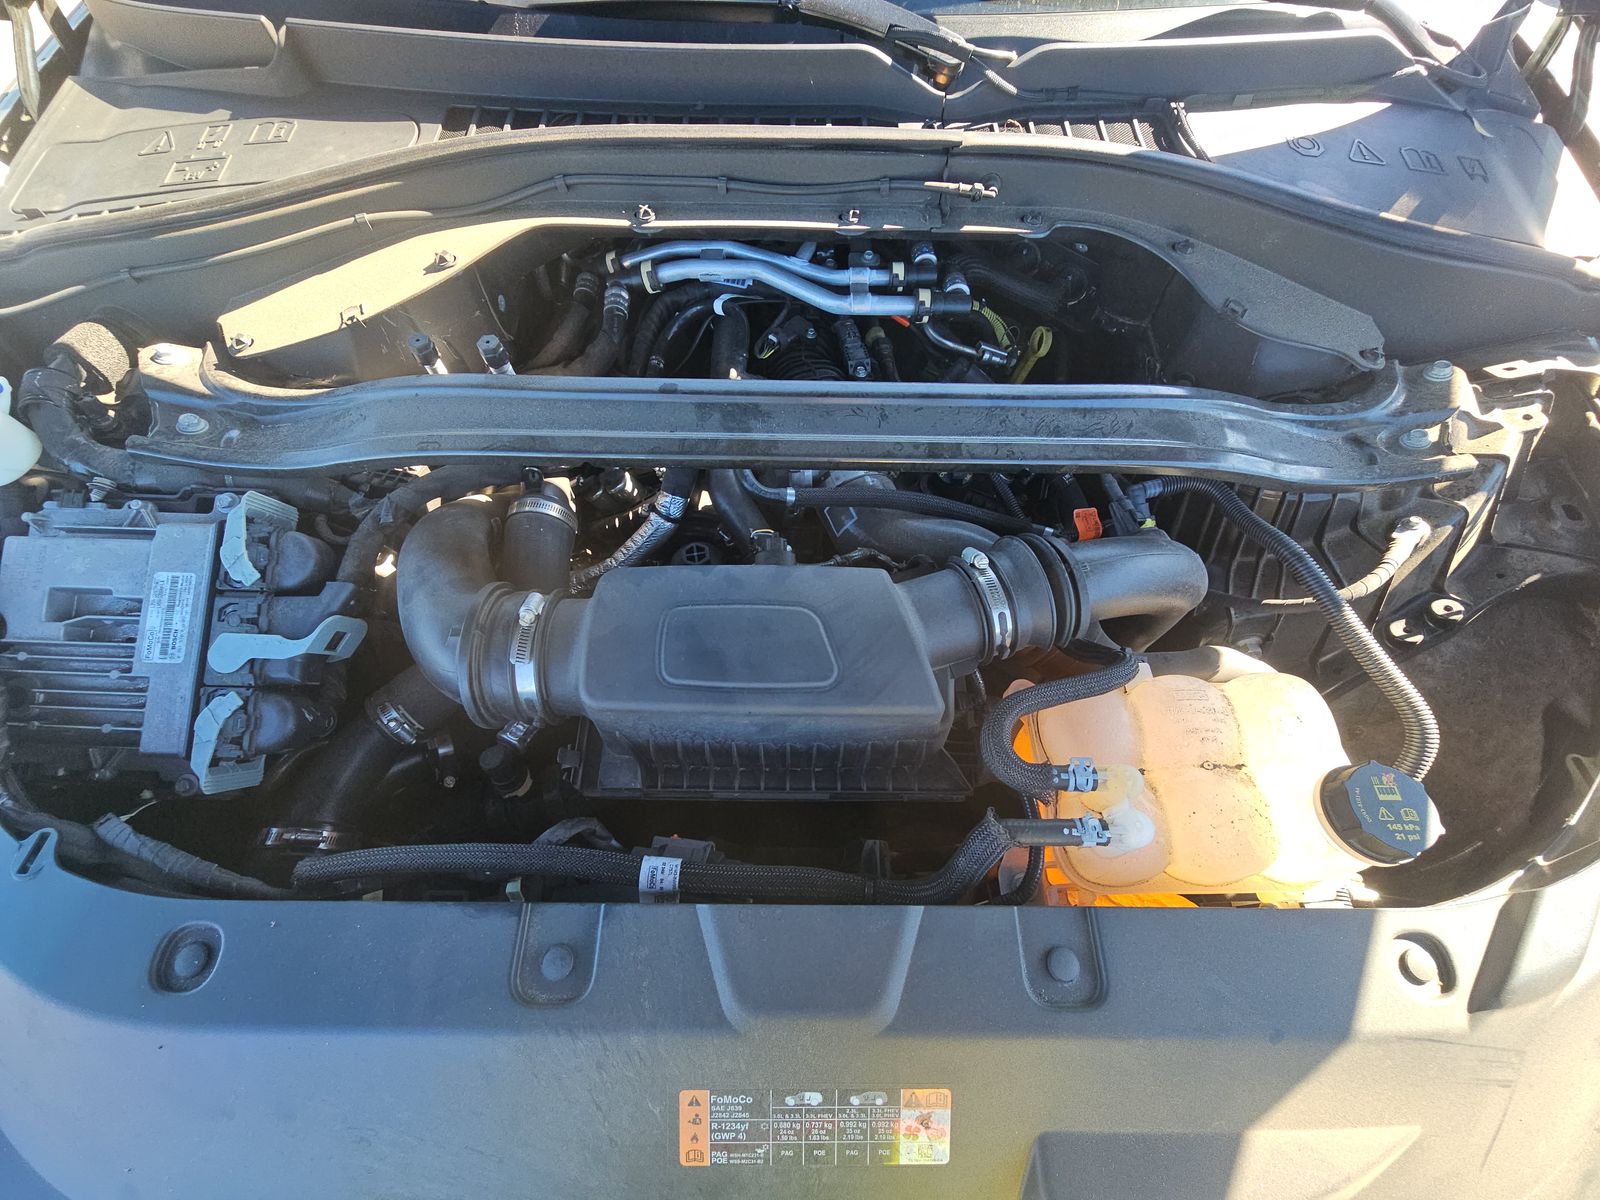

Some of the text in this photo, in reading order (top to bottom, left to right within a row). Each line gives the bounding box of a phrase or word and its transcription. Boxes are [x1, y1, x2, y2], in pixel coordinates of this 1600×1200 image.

[171, 629, 179, 650] BOSCH
[144, 631, 155, 659] FoMoCo
[1386, 823, 1421, 831] 145 kPa
[1407, 833, 1420, 841] psi
[710, 1095, 753, 1104] FoMoCo
[711, 1122, 749, 1132] R-1234yf
[792, 1121, 801, 1130] kg
[805, 1121, 833, 1130] 0.737 kg
[858, 1120, 867, 1129] kg
[711, 1132, 747, 1141] (GWP 4)
